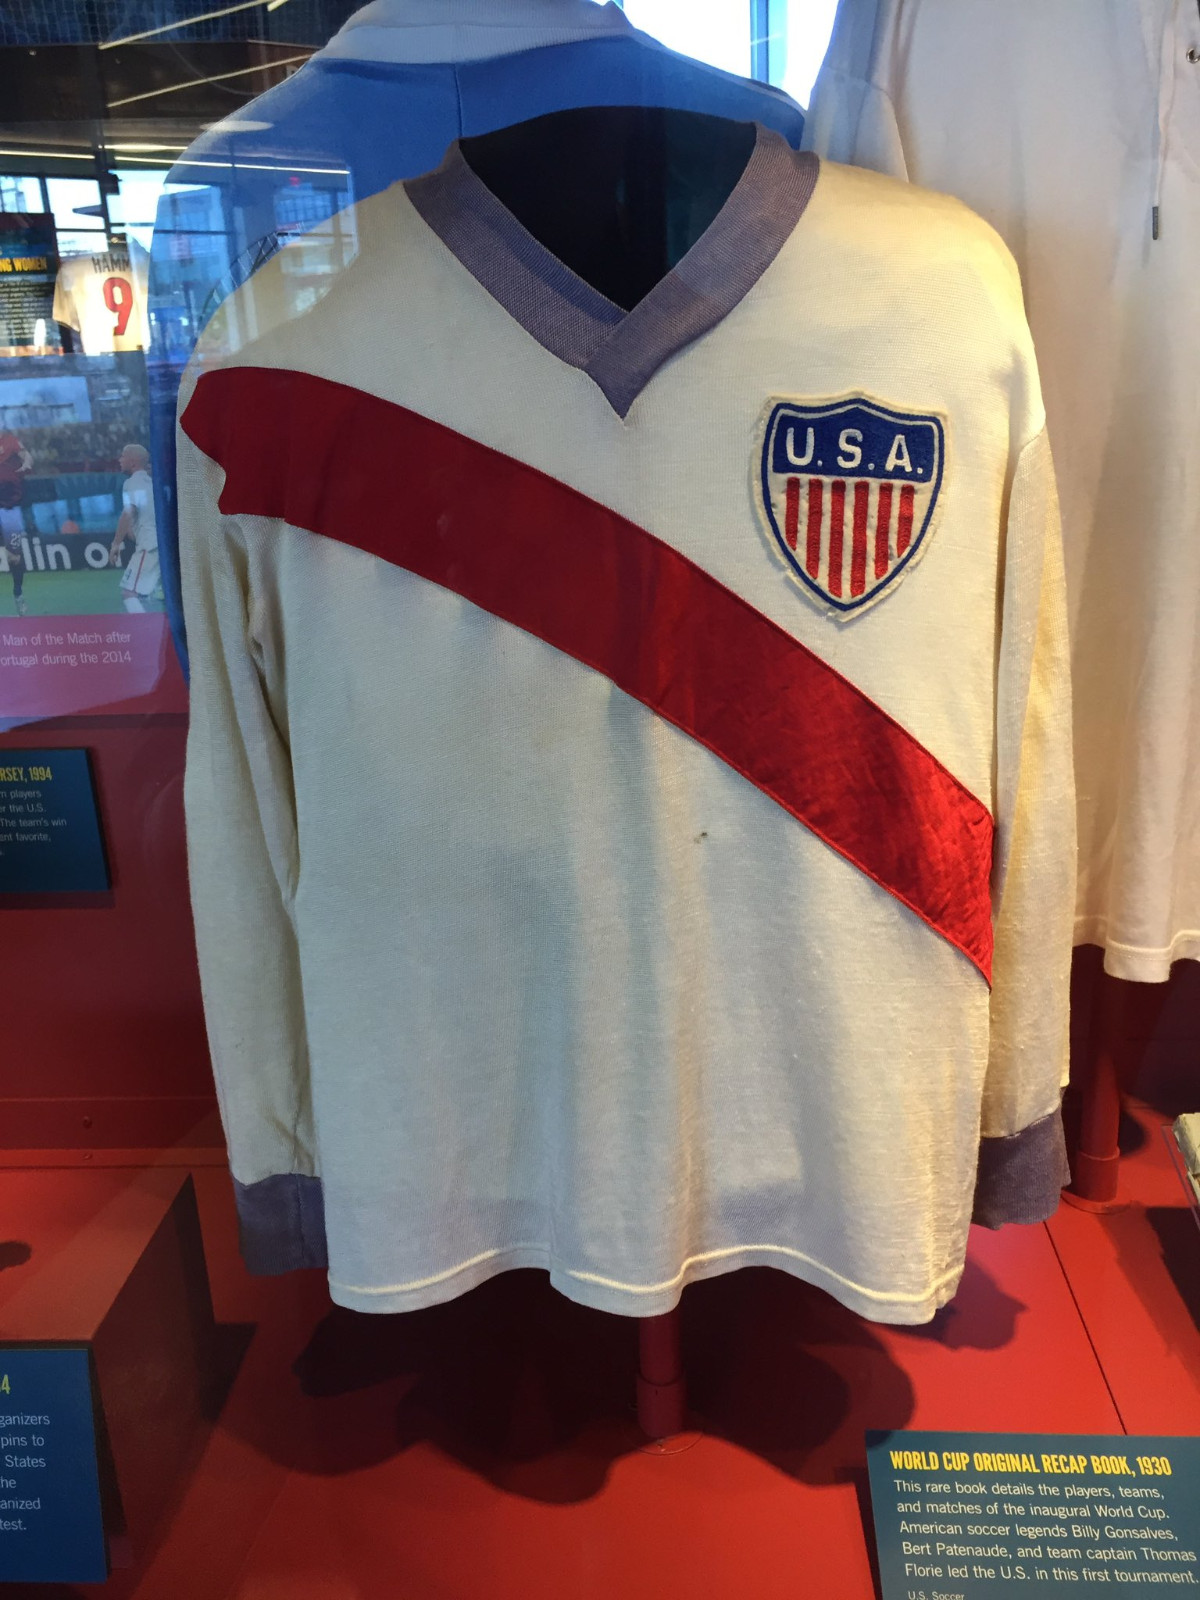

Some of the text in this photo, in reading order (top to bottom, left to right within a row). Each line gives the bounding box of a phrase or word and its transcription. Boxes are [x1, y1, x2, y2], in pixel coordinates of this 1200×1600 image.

[13, 256, 47, 272] WOMEN
[91, 254, 132, 273] HAMM
[103, 277, 133, 336] 9
[3, 631, 131, 646] Man of the Match after
[42, 653, 79, 667] during
[80, 652, 98, 664] the
[102, 651, 132, 663] 2014
[29, 766, 53, 781] 1994
[10, 789, 42, 800] players
[9, 804, 24, 813] the
[19, 817, 49, 827] team's
[51, 817, 67, 826] win
[1, 1433, 45, 1449] pins to
[5, 1454, 47, 1468] States
[889, 1451, 1172, 1478] WORLD CUP ORIGINAL RECAP BOOK, 1930
[893, 1479, 1165, 1500] This rare book details the players, teams,
[897, 1501, 1170, 1521] and matches of the inaugural World Cup.
[899, 1520, 1178, 1541] American soccer legends Billy Gonsalves,
[902, 1541, 1197, 1563] Bert Patenaude, and team captain Thomas
[904, 1563, 1199, 1584] Florie led the U.S. in this first tournament.
[908, 1591, 965, 1600] U.S. Soccer
